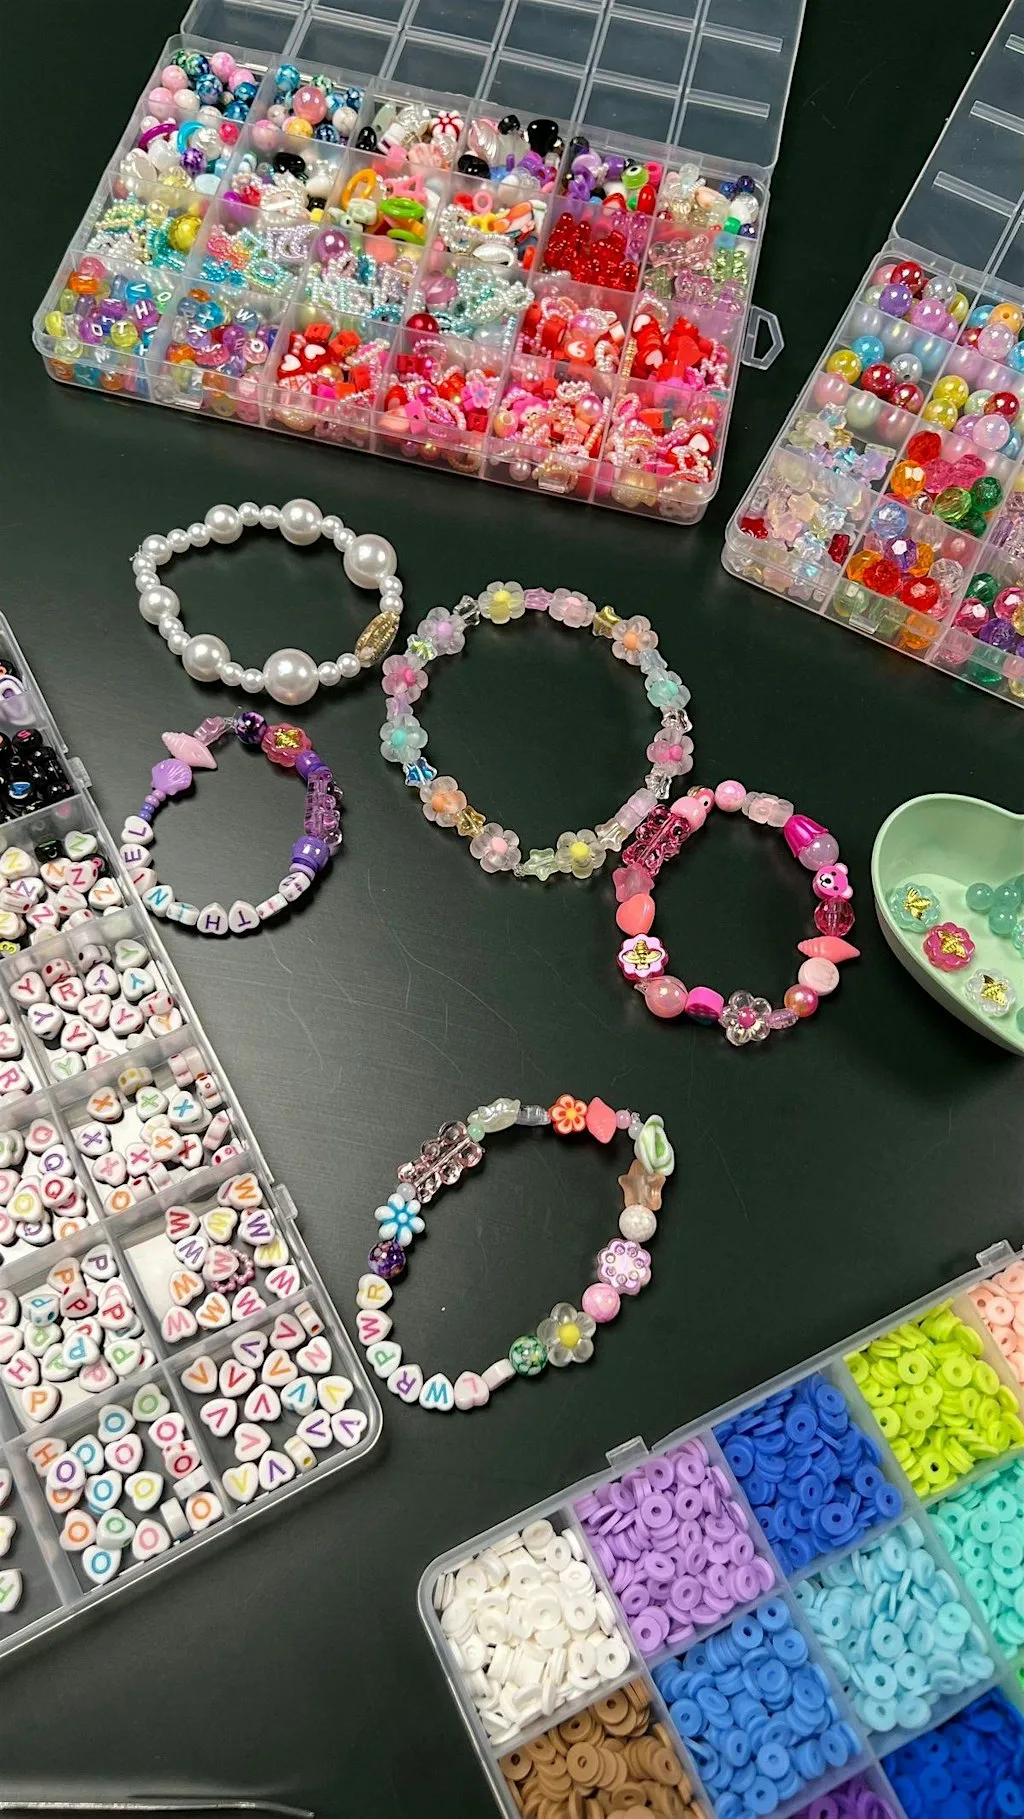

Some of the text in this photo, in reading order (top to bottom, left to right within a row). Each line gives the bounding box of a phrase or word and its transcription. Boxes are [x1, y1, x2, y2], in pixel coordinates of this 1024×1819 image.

[135, 301, 148, 319] H
[128, 826, 147, 837] L
[69, 835, 88, 852] Z
[124, 848, 141, 863] E
[71, 868, 85, 885] Z
[205, 914, 221, 931] H
[237, 911, 251, 927] T
[121, 947, 139, 960] Y
[18, 978, 35, 995] Y
[94, 969, 108, 986] Y
[130, 973, 144, 990] Y
[57, 982, 78, 1001] R
[33, 1011, 54, 1025] Y
[116, 1008, 133, 1025] Y
[66, 1025, 87, 1042] Y
[57, 1058, 72, 1075] Y
[92, 1095, 113, 1112] X
[140, 1093, 159, 1108] X
[173, 1099, 194, 1118] X
[83, 1131, 103, 1148] X
[155, 1135, 173, 1150] X
[44, 1154, 64, 1172] Q
[131, 1149, 150, 1164] X
[100, 1157, 119, 1176] X
[45, 1179, 64, 1199] Q
[88, 1255, 109, 1270] P
[54, 1268, 74, 1284] P
[367, 1284, 386, 1301] R
[66, 1299, 88, 1311] P
[102, 1303, 125, 1320] P
[276, 1321, 297, 1339] V
[112, 1347, 134, 1365] P
[374, 1350, 396, 1367] P
[8, 1358, 32, 1382] H
[188, 1362, 208, 1384] V
[270, 1356, 292, 1376] V
[228, 1366, 247, 1388] V
[396, 1371, 416, 1395] R
[31, 1391, 48, 1413] P
[138, 1394, 158, 1414] O
[104, 1412, 125, 1433] O
[156, 1421, 177, 1442] O
[240, 1433, 261, 1452] V
[76, 1443, 96, 1464] O
[115, 1443, 134, 1465] O
[56, 1460, 76, 1483] O
[174, 1455, 193, 1473] O
[93, 1479, 113, 1501] O
[134, 1478, 155, 1499] O
[229, 1469, 248, 1493] V
[191, 1497, 211, 1520] O
[68, 1520, 89, 1543] O
[105, 1516, 126, 1534] O
[139, 1527, 159, 1550] O
[91, 1551, 111, 1574] O
